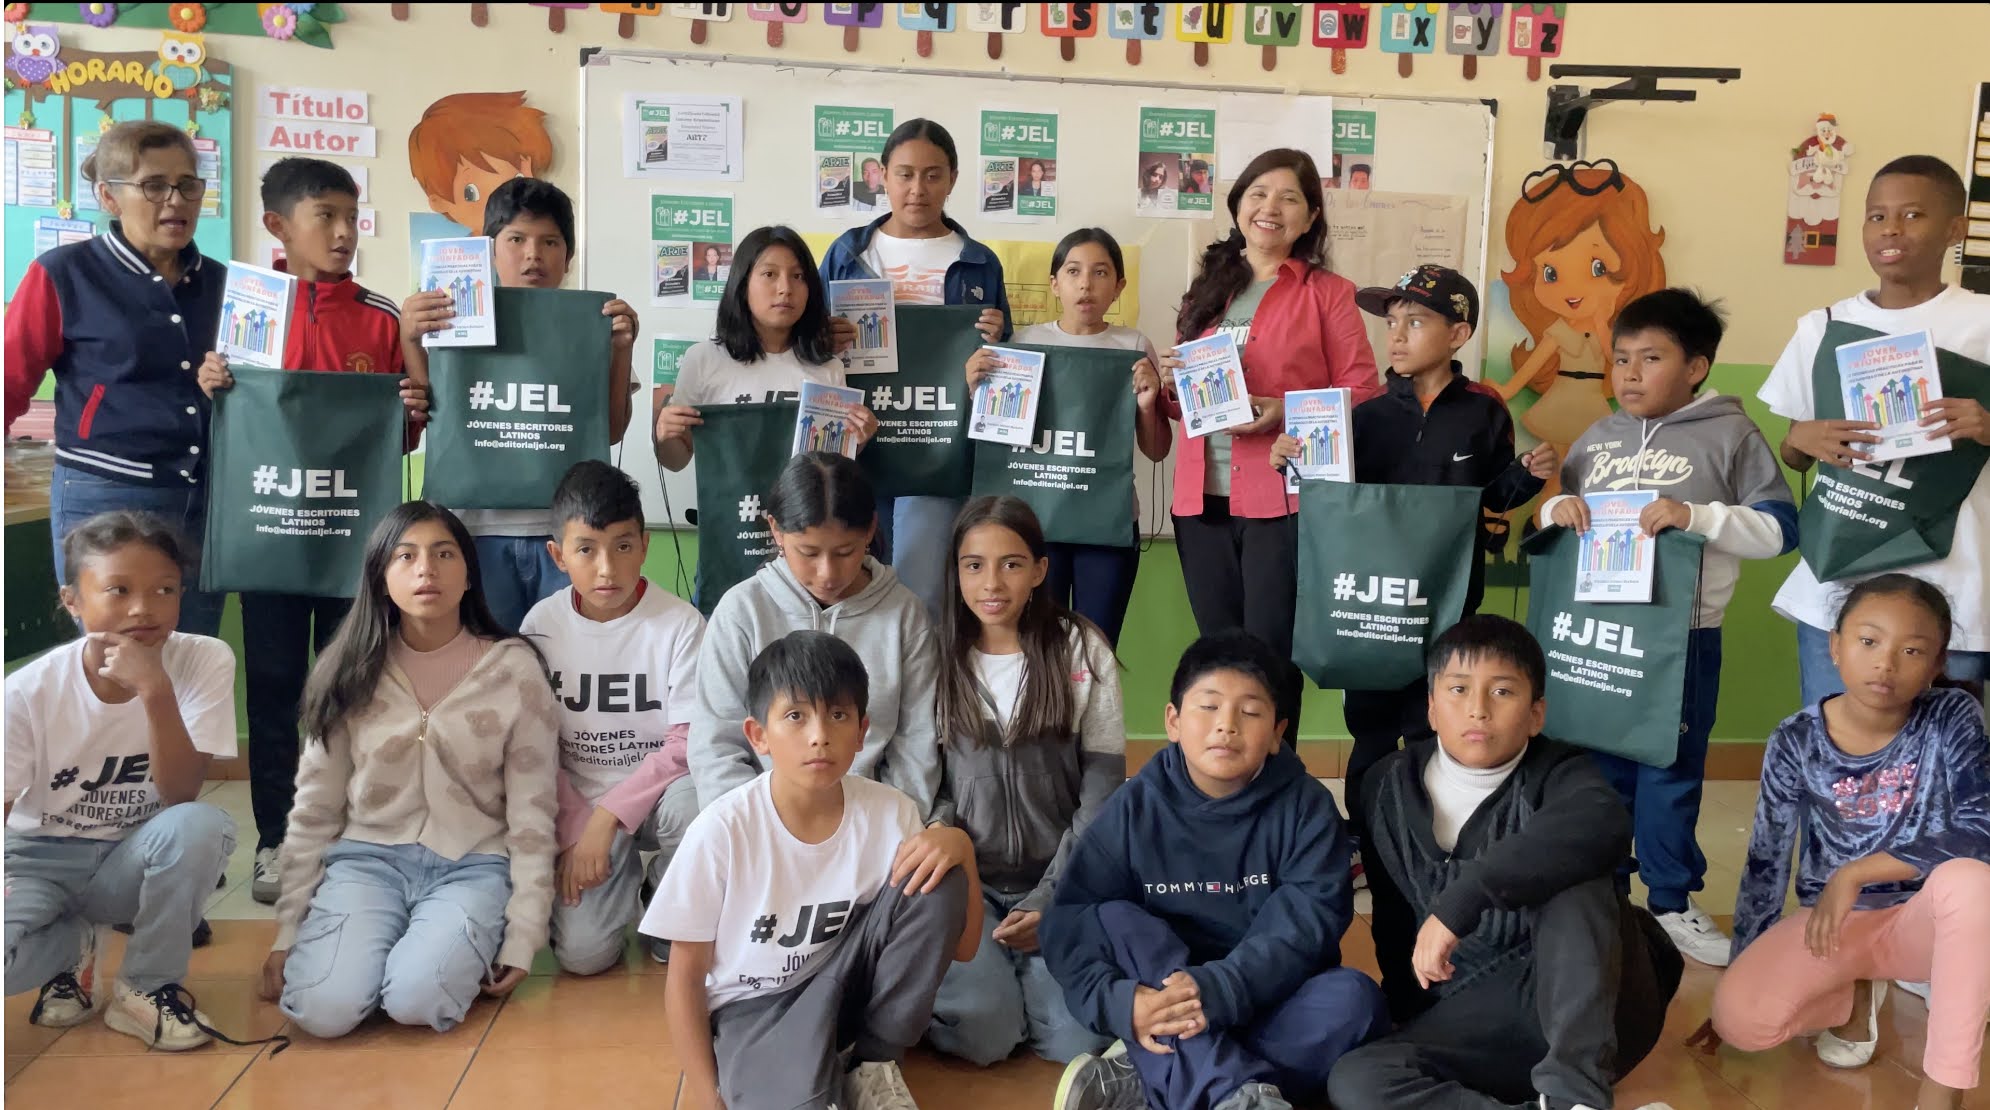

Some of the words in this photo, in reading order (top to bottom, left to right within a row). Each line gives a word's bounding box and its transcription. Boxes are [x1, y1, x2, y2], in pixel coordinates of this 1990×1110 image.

[1001, 3, 1021, 30] r
[1141, 3, 1159, 35] t
[1206, 3, 1224, 39] u
[1275, 11, 1297, 39] v
[1342, 14, 1365, 41] w
[1413, 17, 1431, 47] x
[1477, 17, 1495, 51] y
[1541, 23, 1559, 53] z
[50, 59, 174, 99] HORARIO
[269, 92, 364, 120] Título
[835, 120, 891, 138] #JEL
[1001, 125, 1055, 143] #JEL
[1160, 121, 1212, 138] #JEL
[1334, 122, 1372, 140] JEL
[269, 126, 360, 153] Autor
[1028, 200, 1054, 209] #JEL
[1187, 197, 1211, 205] #JEL
[673, 209, 730, 227] #JEL
[704, 285, 725, 294] #JE
[469, 381, 571, 413] #JEL
[872, 386, 957, 411] #JEL
[467, 420, 512, 430] JÓVENES
[514, 422, 574, 432] ESCRITORES
[877, 420, 908, 428] VENES
[909, 420, 959, 428] ESCRITORES
[897, 428, 932, 436] LATINOS
[500, 431, 541, 440] LATINOS
[1012, 429, 1096, 458] JEL
[474, 439, 566, 452] info@editorialjel.org
[1586, 443, 1603, 453] NEW
[1604, 440, 1623, 450] YORK
[1007, 461, 1045, 471] JÓVENES
[1046, 464, 1097, 474] ESCRITORES
[1034, 471, 1068, 481] LATINOS
[253, 464, 358, 498] #JEL
[1013, 478, 1089, 491] info@editorialjel.org
[1826, 488, 1863, 509] ATINOS
[1835, 481, 1906, 511] ESCRITORES
[249, 504, 295, 517] JÓVENES
[297, 508, 360, 518] ESCRITORES
[256, 523, 352, 537] info@editorialjel.org
[281, 517, 326, 527] LATINOS
[1333, 572, 1428, 607] #JEL
[1330, 609, 1372, 621] JÓVENES
[1374, 614, 1430, 625] ESCRITORES
[1336, 628, 1424, 644] info@editorialjel.org
[1359, 621, 1400, 633] LATINOS
[1552, 611, 1645, 659] #JEL
[1547, 649, 1584, 666] JÓVENES
[1585, 659, 1644, 679] ESCRITORES
[1570, 665, 1609, 681] LATINOS
[1550, 668, 1633, 698] info@editorialjel.org
[573, 729, 636, 742] JÓVENES
[559, 736, 615, 755] RITORES
[619, 739, 666, 751] LATIN
[50, 752, 153, 791] #JE
[66, 806, 124, 823] ITORES
[126, 800, 162, 819] LATIN
[1144, 881, 1204, 895] TOMMY
[1224, 873, 1269, 895] HILFGE
[749, 899, 852, 948] #JE
